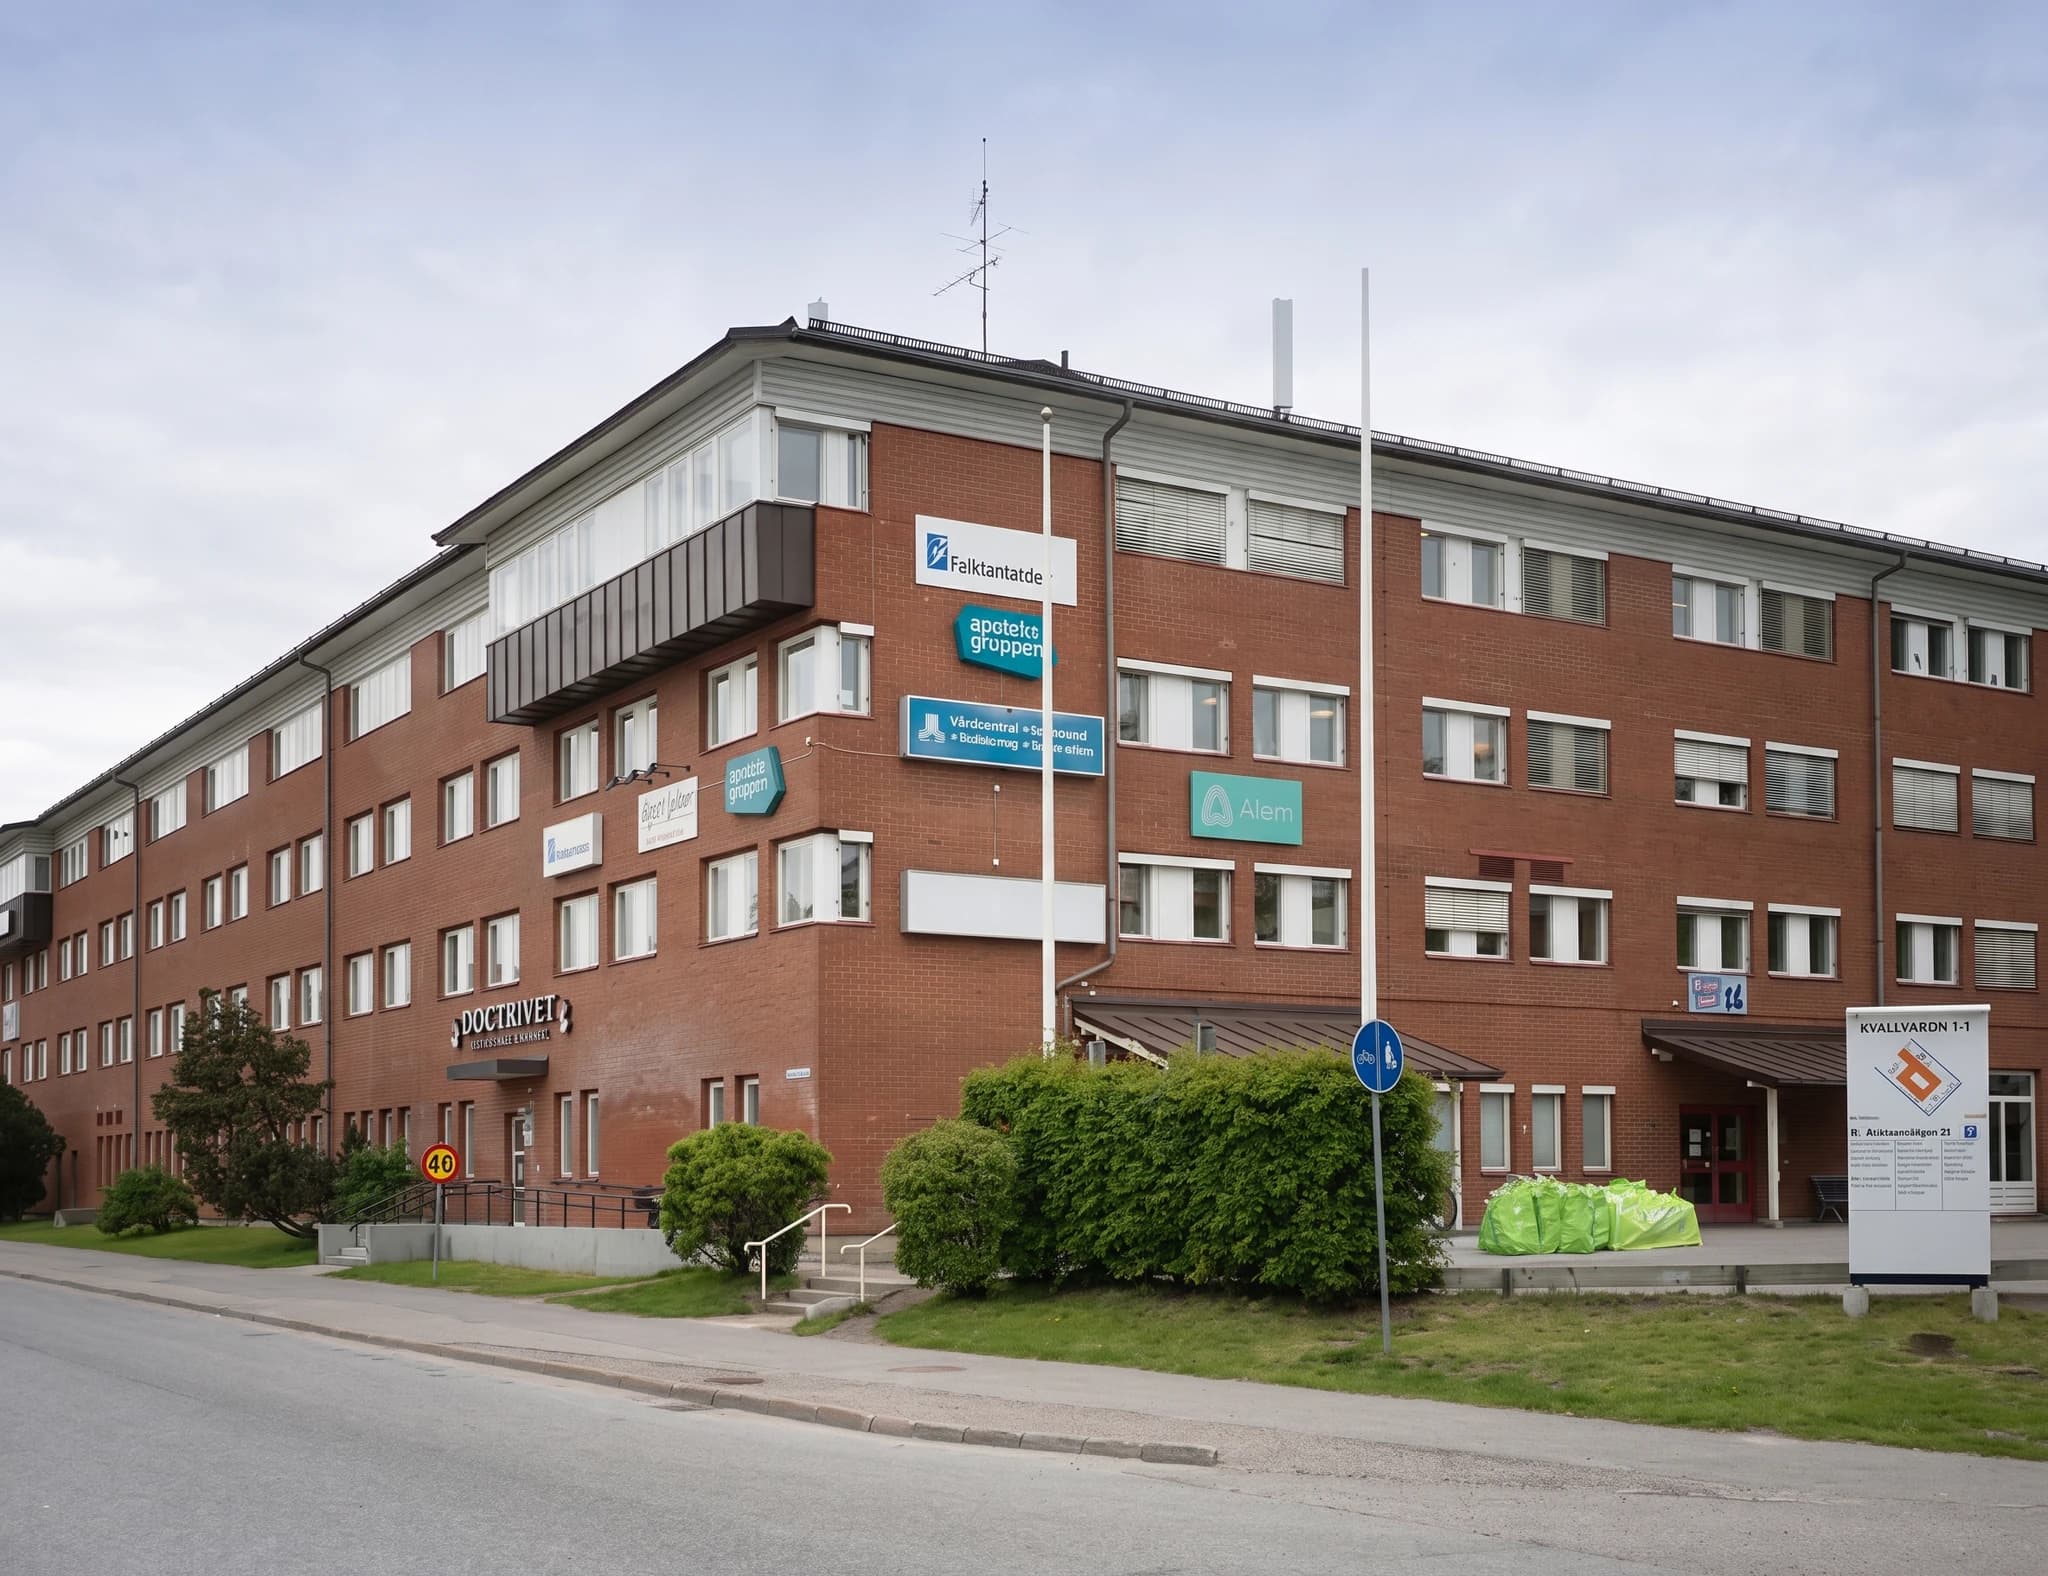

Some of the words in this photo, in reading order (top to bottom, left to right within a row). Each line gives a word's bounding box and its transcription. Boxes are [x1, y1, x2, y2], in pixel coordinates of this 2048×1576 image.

[950, 715, 1019, 734] Vårdcentral
[1239, 798, 1293, 823] Alem
[462, 994, 557, 1036] DOCTRIVET
[1860, 1021, 1948, 1034] KVALLVARDN
[1952, 1021, 1970, 1032] 1-1
[1940, 1128, 1951, 1136] 21
[428, 1154, 453, 1174] 40
